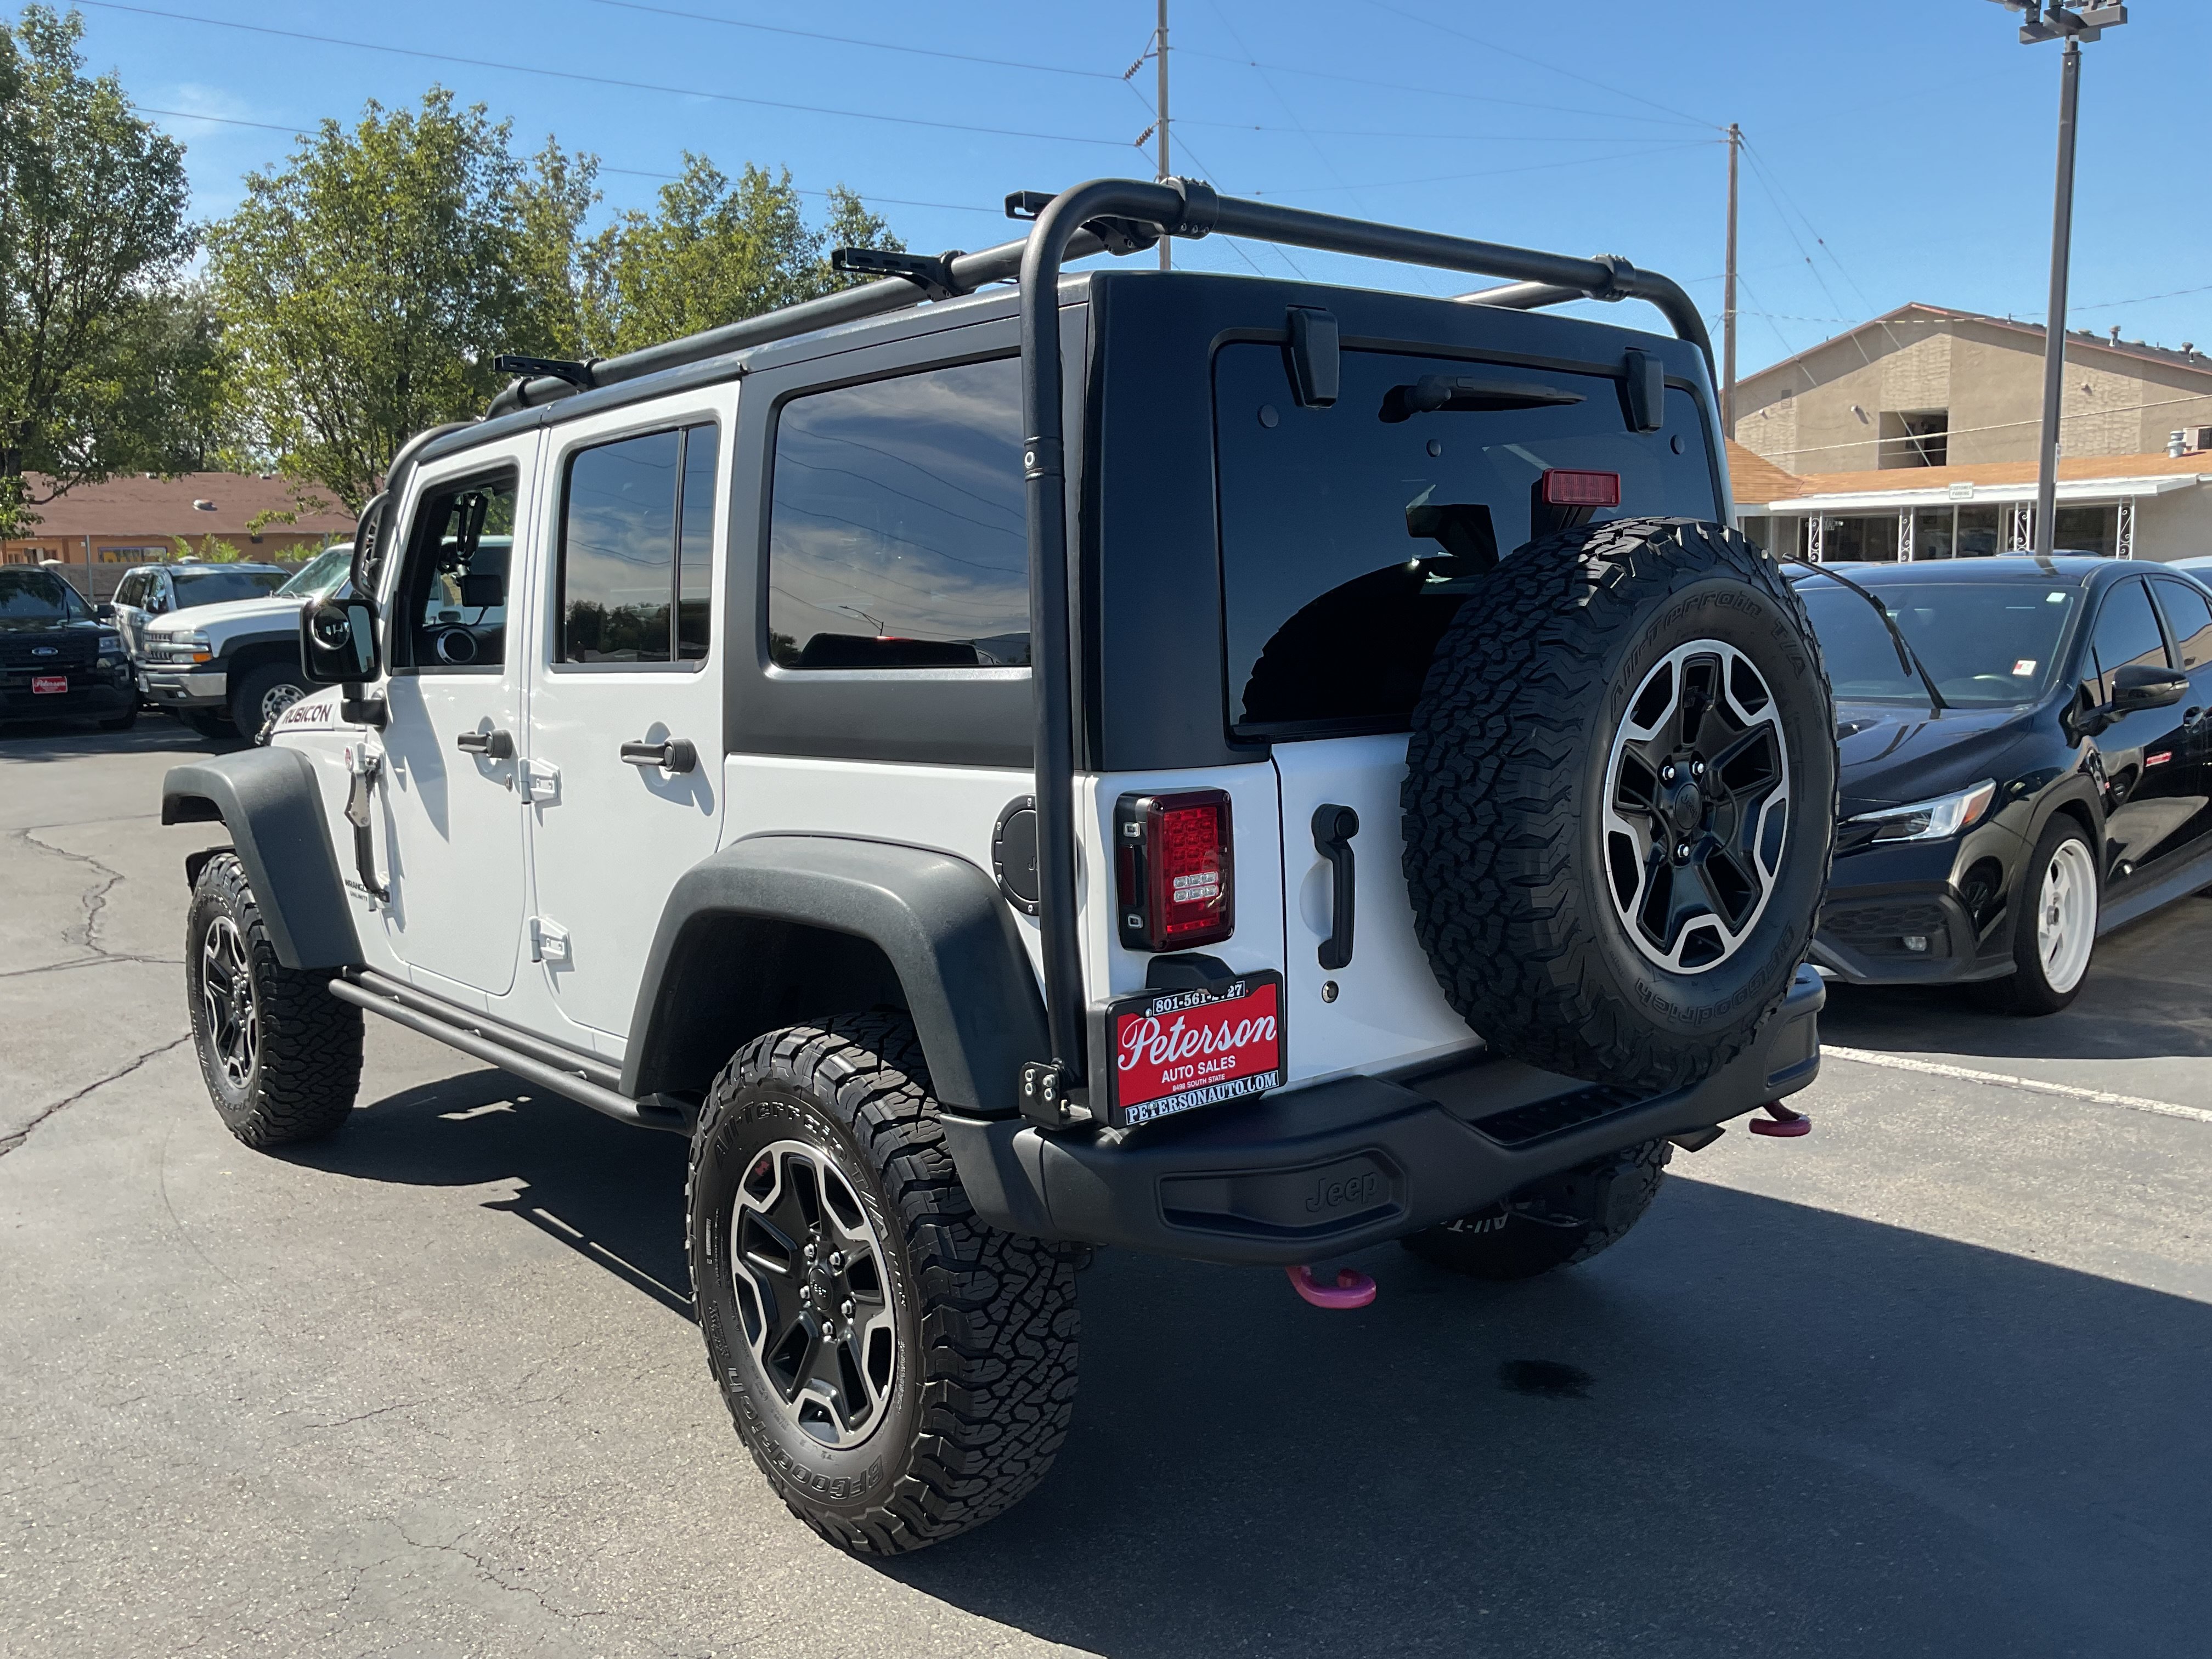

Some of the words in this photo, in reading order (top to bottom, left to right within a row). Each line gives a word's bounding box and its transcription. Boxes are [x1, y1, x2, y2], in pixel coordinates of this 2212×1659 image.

[283, 704, 333, 724] RUBICON
[1155, 983, 1243, 1013] 801-561-27
[1118, 1015, 1277, 1070] Peterson
[1161, 1063, 1194, 1084] AUTO
[1197, 1055, 1236, 1075] SALES
[1172, 1082, 1186, 1092] 8498
[1187, 1077, 1207, 1088] SOUTH
[1208, 1073, 1226, 1084] STATE
[1127, 1073, 1277, 1124] PETERSONAUTO.COM
[1305, 1171, 1379, 1212] Jeep
